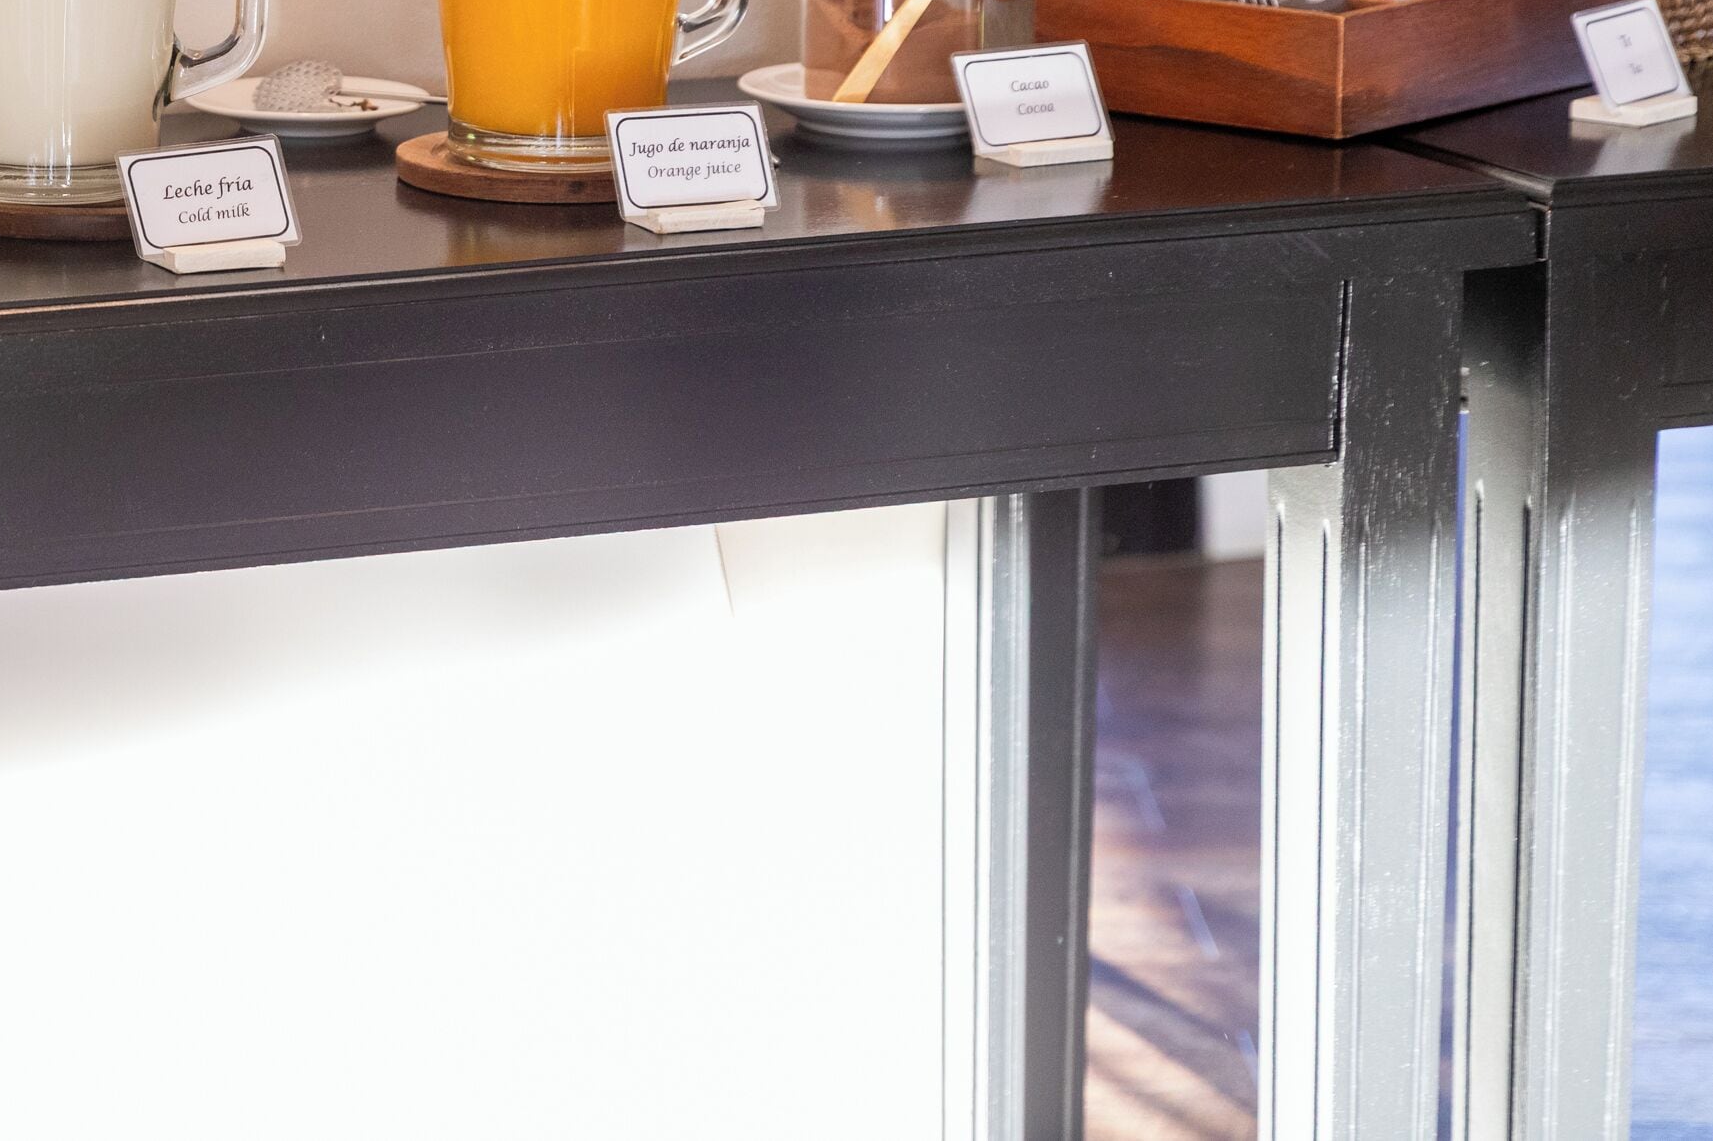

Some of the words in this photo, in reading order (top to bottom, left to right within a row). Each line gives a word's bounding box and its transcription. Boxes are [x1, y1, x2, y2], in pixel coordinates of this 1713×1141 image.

[1010, 79, 1050, 93] Cacao
[1017, 101, 1056, 116] Cocoa
[628, 141, 664, 158] Jugo
[668, 137, 685, 152] de
[688, 135, 751, 154] naranja
[647, 164, 702, 181] Orange
[704, 161, 742, 180] juice
[163, 179, 214, 200] Leche
[216, 176, 254, 200] fría
[178, 206, 213, 224] Cold
[216, 202, 251, 220] milk
